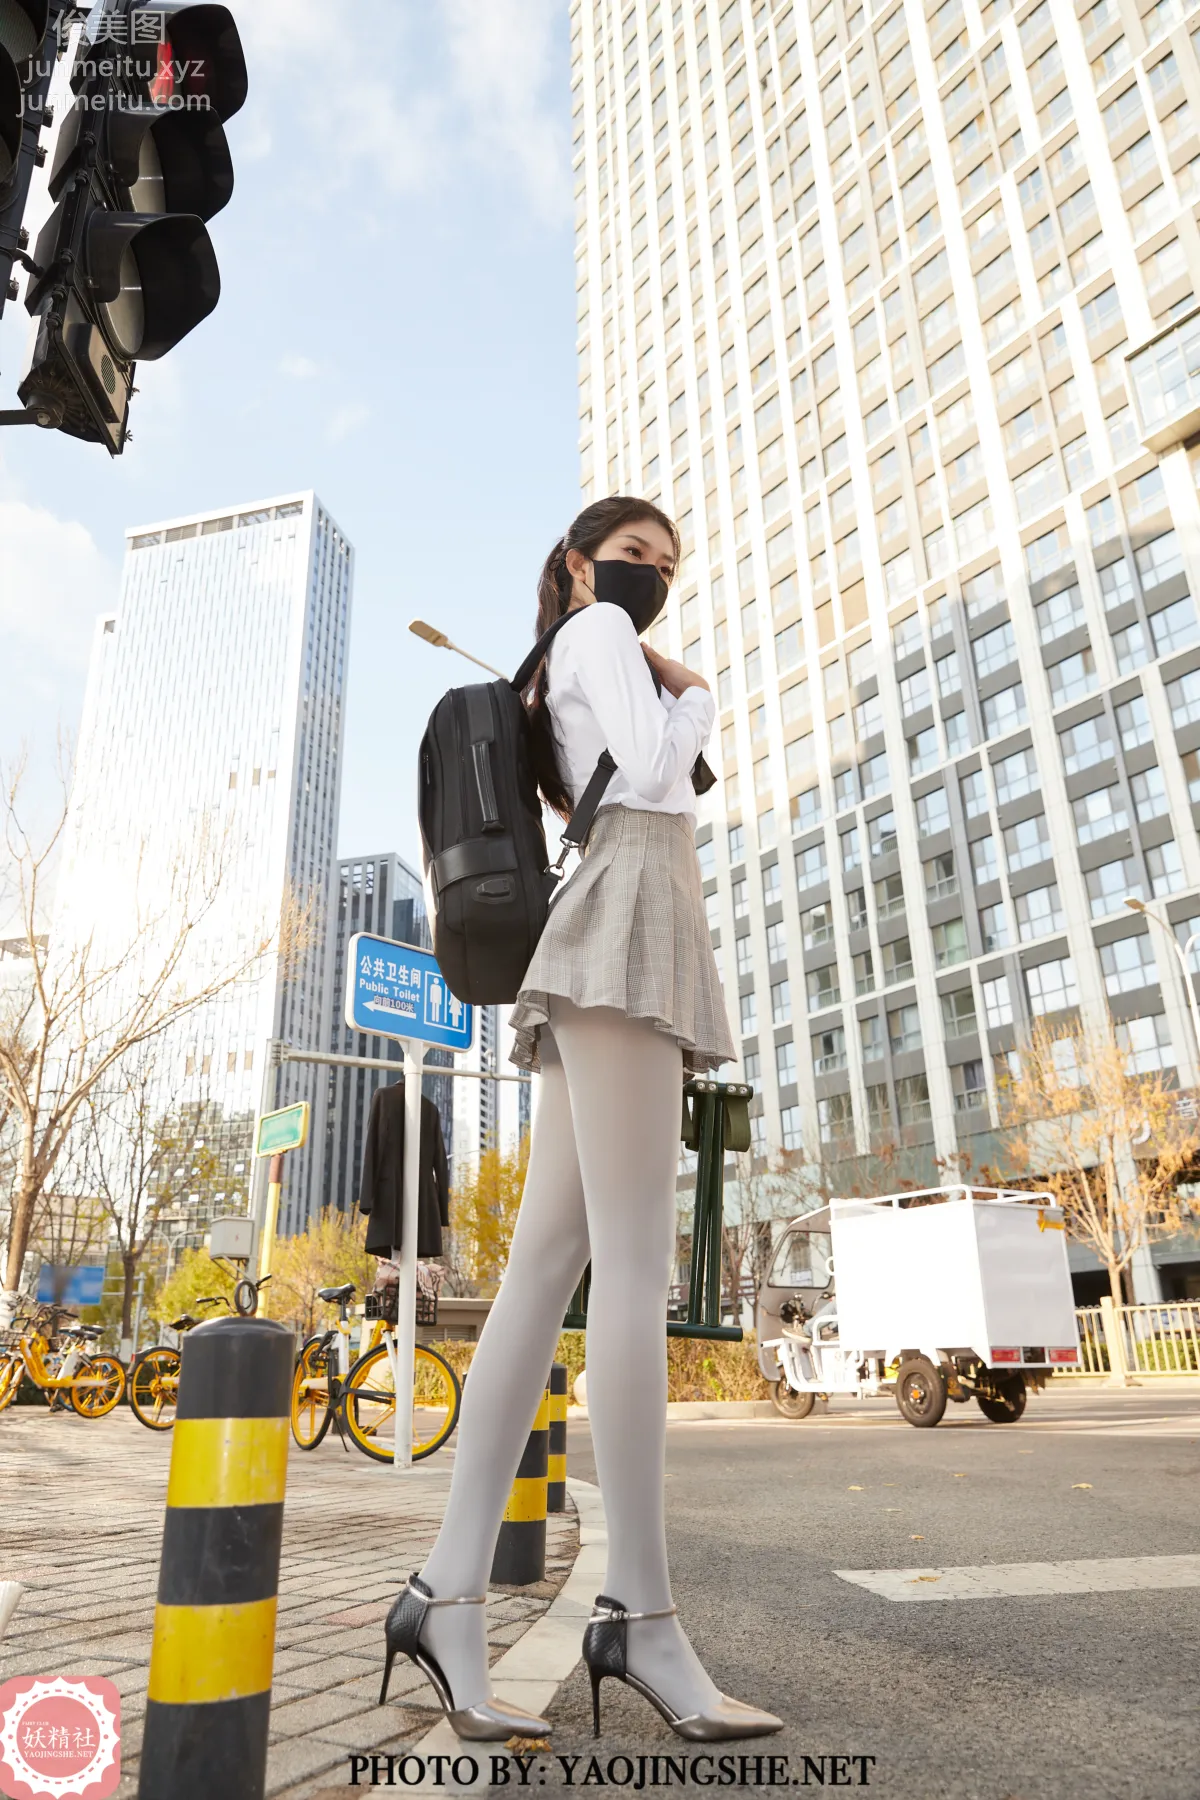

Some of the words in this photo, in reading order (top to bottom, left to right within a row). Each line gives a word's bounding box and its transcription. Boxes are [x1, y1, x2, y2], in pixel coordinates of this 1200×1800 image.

[360, 955, 421, 989] 公共卫生间
[360, 978, 389, 994] Public
[393, 986, 420, 1003] Toilet
